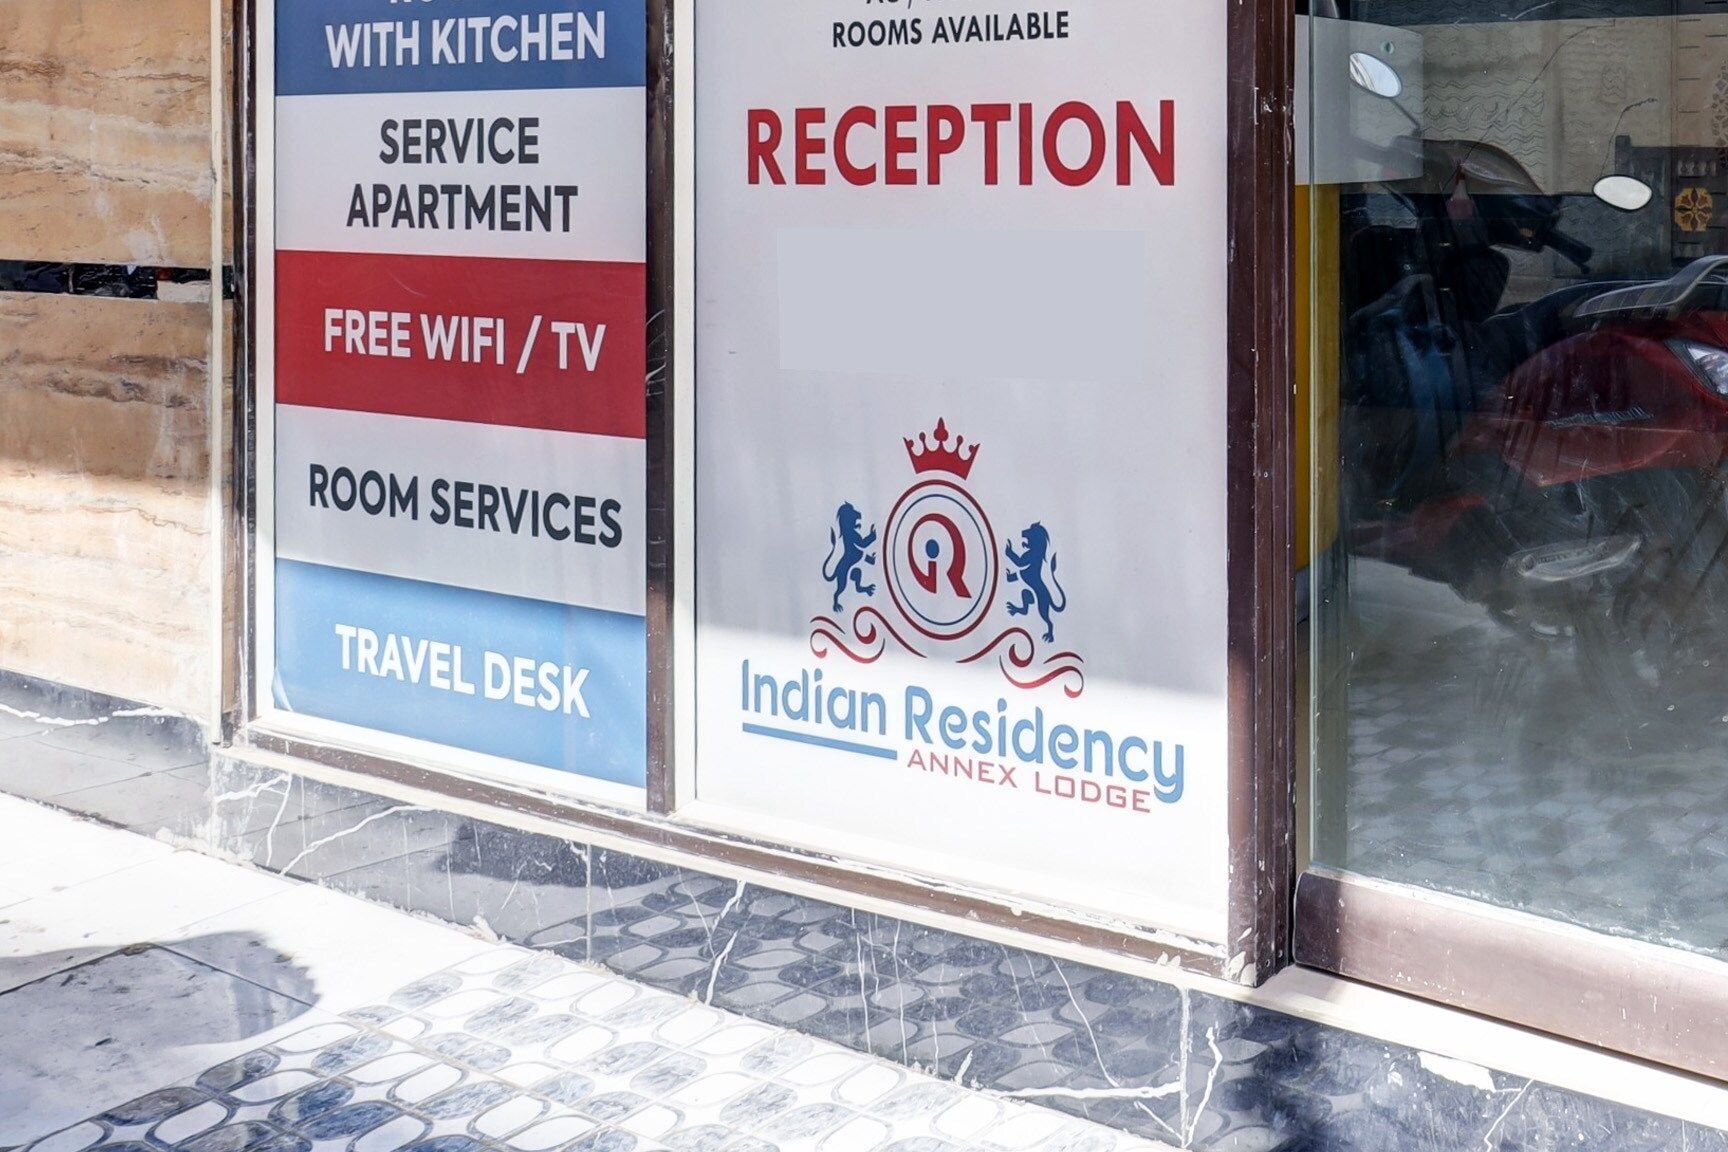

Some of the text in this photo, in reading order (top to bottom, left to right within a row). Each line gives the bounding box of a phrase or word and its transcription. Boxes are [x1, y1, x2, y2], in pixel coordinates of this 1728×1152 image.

[325, 10, 607, 69] WITH KITCHEN
[832, 10, 1069, 48] ROOMS AVAILABLE
[379, 117, 541, 165] SERVICE
[746, 99, 1176, 187] RECEPTION
[346, 183, 579, 233] APARTMENT
[324, 308, 411, 359] FREE
[420, 313, 505, 366] WIFI
[551, 320, 607, 372] TV
[309, 462, 623, 549] ROOM SERVICES
[334, 623, 591, 719] TRAVEL DESK
[741, 658, 1186, 805] Indian Residency
[907, 748, 1152, 814] ANNEX LODGE
